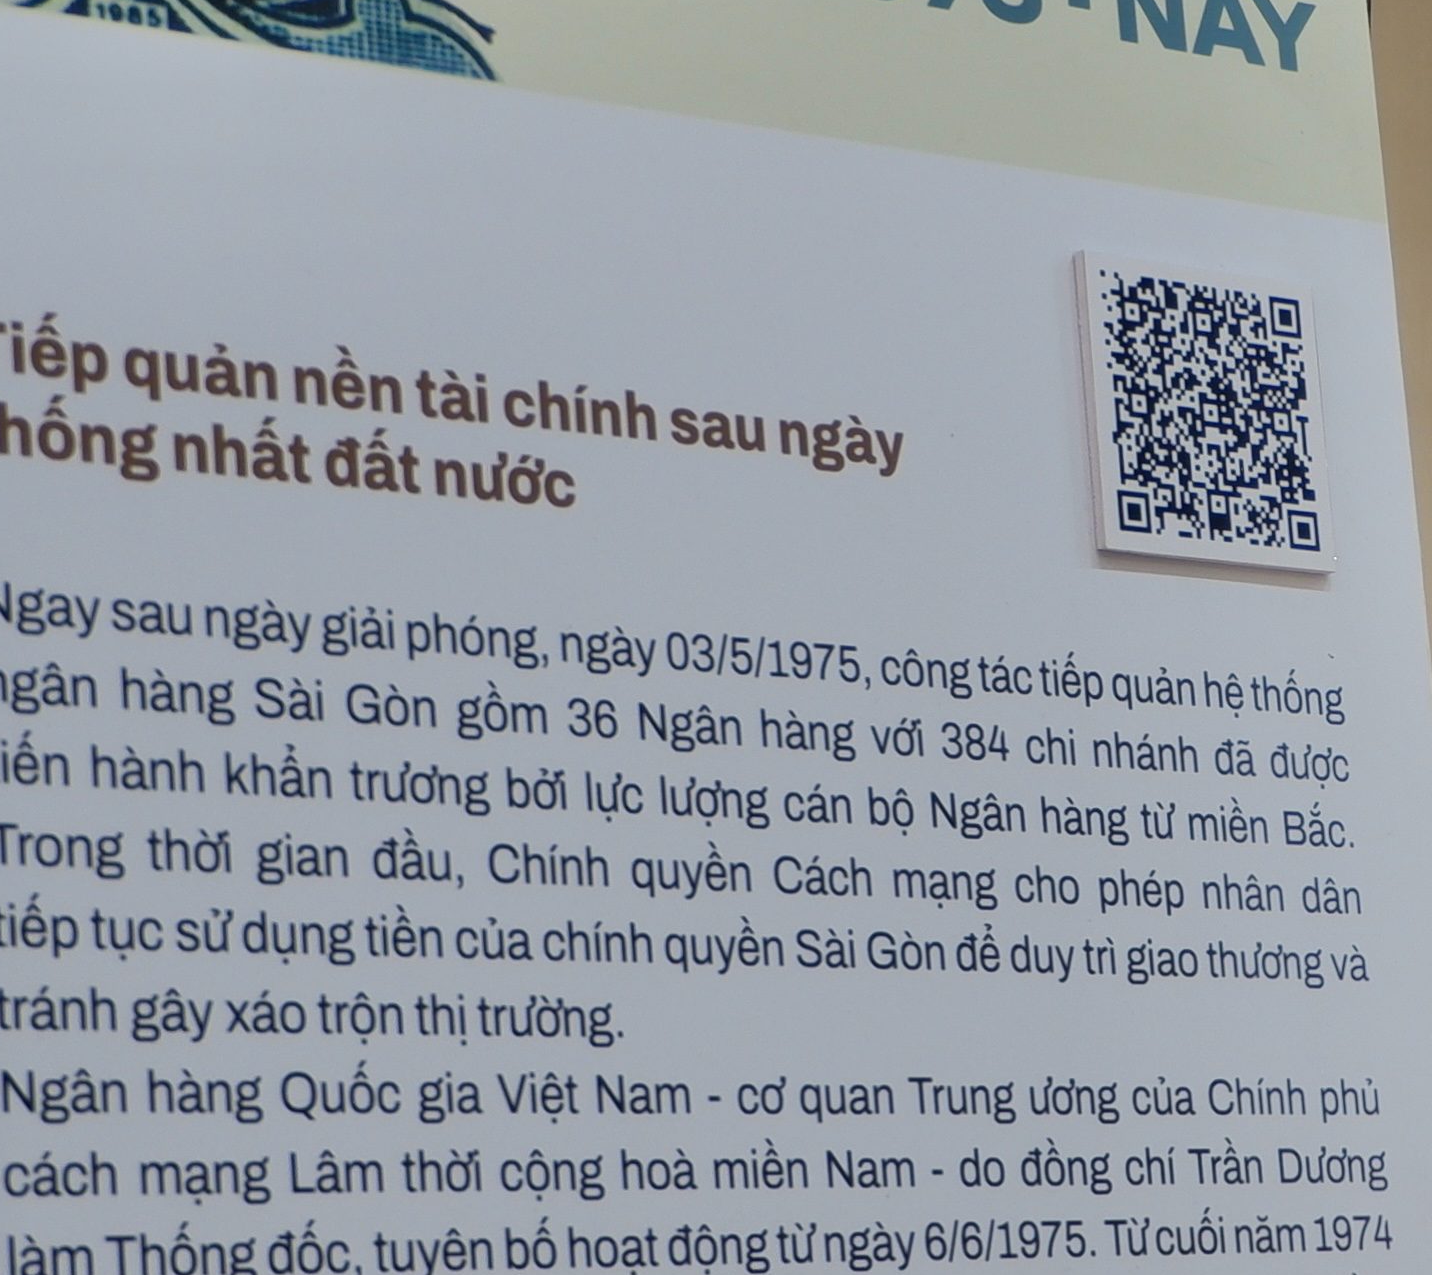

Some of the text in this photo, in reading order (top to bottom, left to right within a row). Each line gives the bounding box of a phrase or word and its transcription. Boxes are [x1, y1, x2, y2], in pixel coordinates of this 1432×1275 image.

[123, 343, 278, 401] quản
[293, 345, 403, 414] nền
[415, 369, 489, 423] tài
[503, 380, 657, 441] chính
[671, 408, 766, 452] sau
[779, 415, 903, 477] ngày
[173, 416, 312, 484] nhất
[325, 427, 421, 494] đất
[434, 451, 576, 508] nước
[131, 988, 213, 1043] gây
[226, 990, 306, 1034] xáo
[317, 992, 404, 1045] trộn
[414, 993, 467, 1046] thị
[476, 995, 624, 1048] trường.
